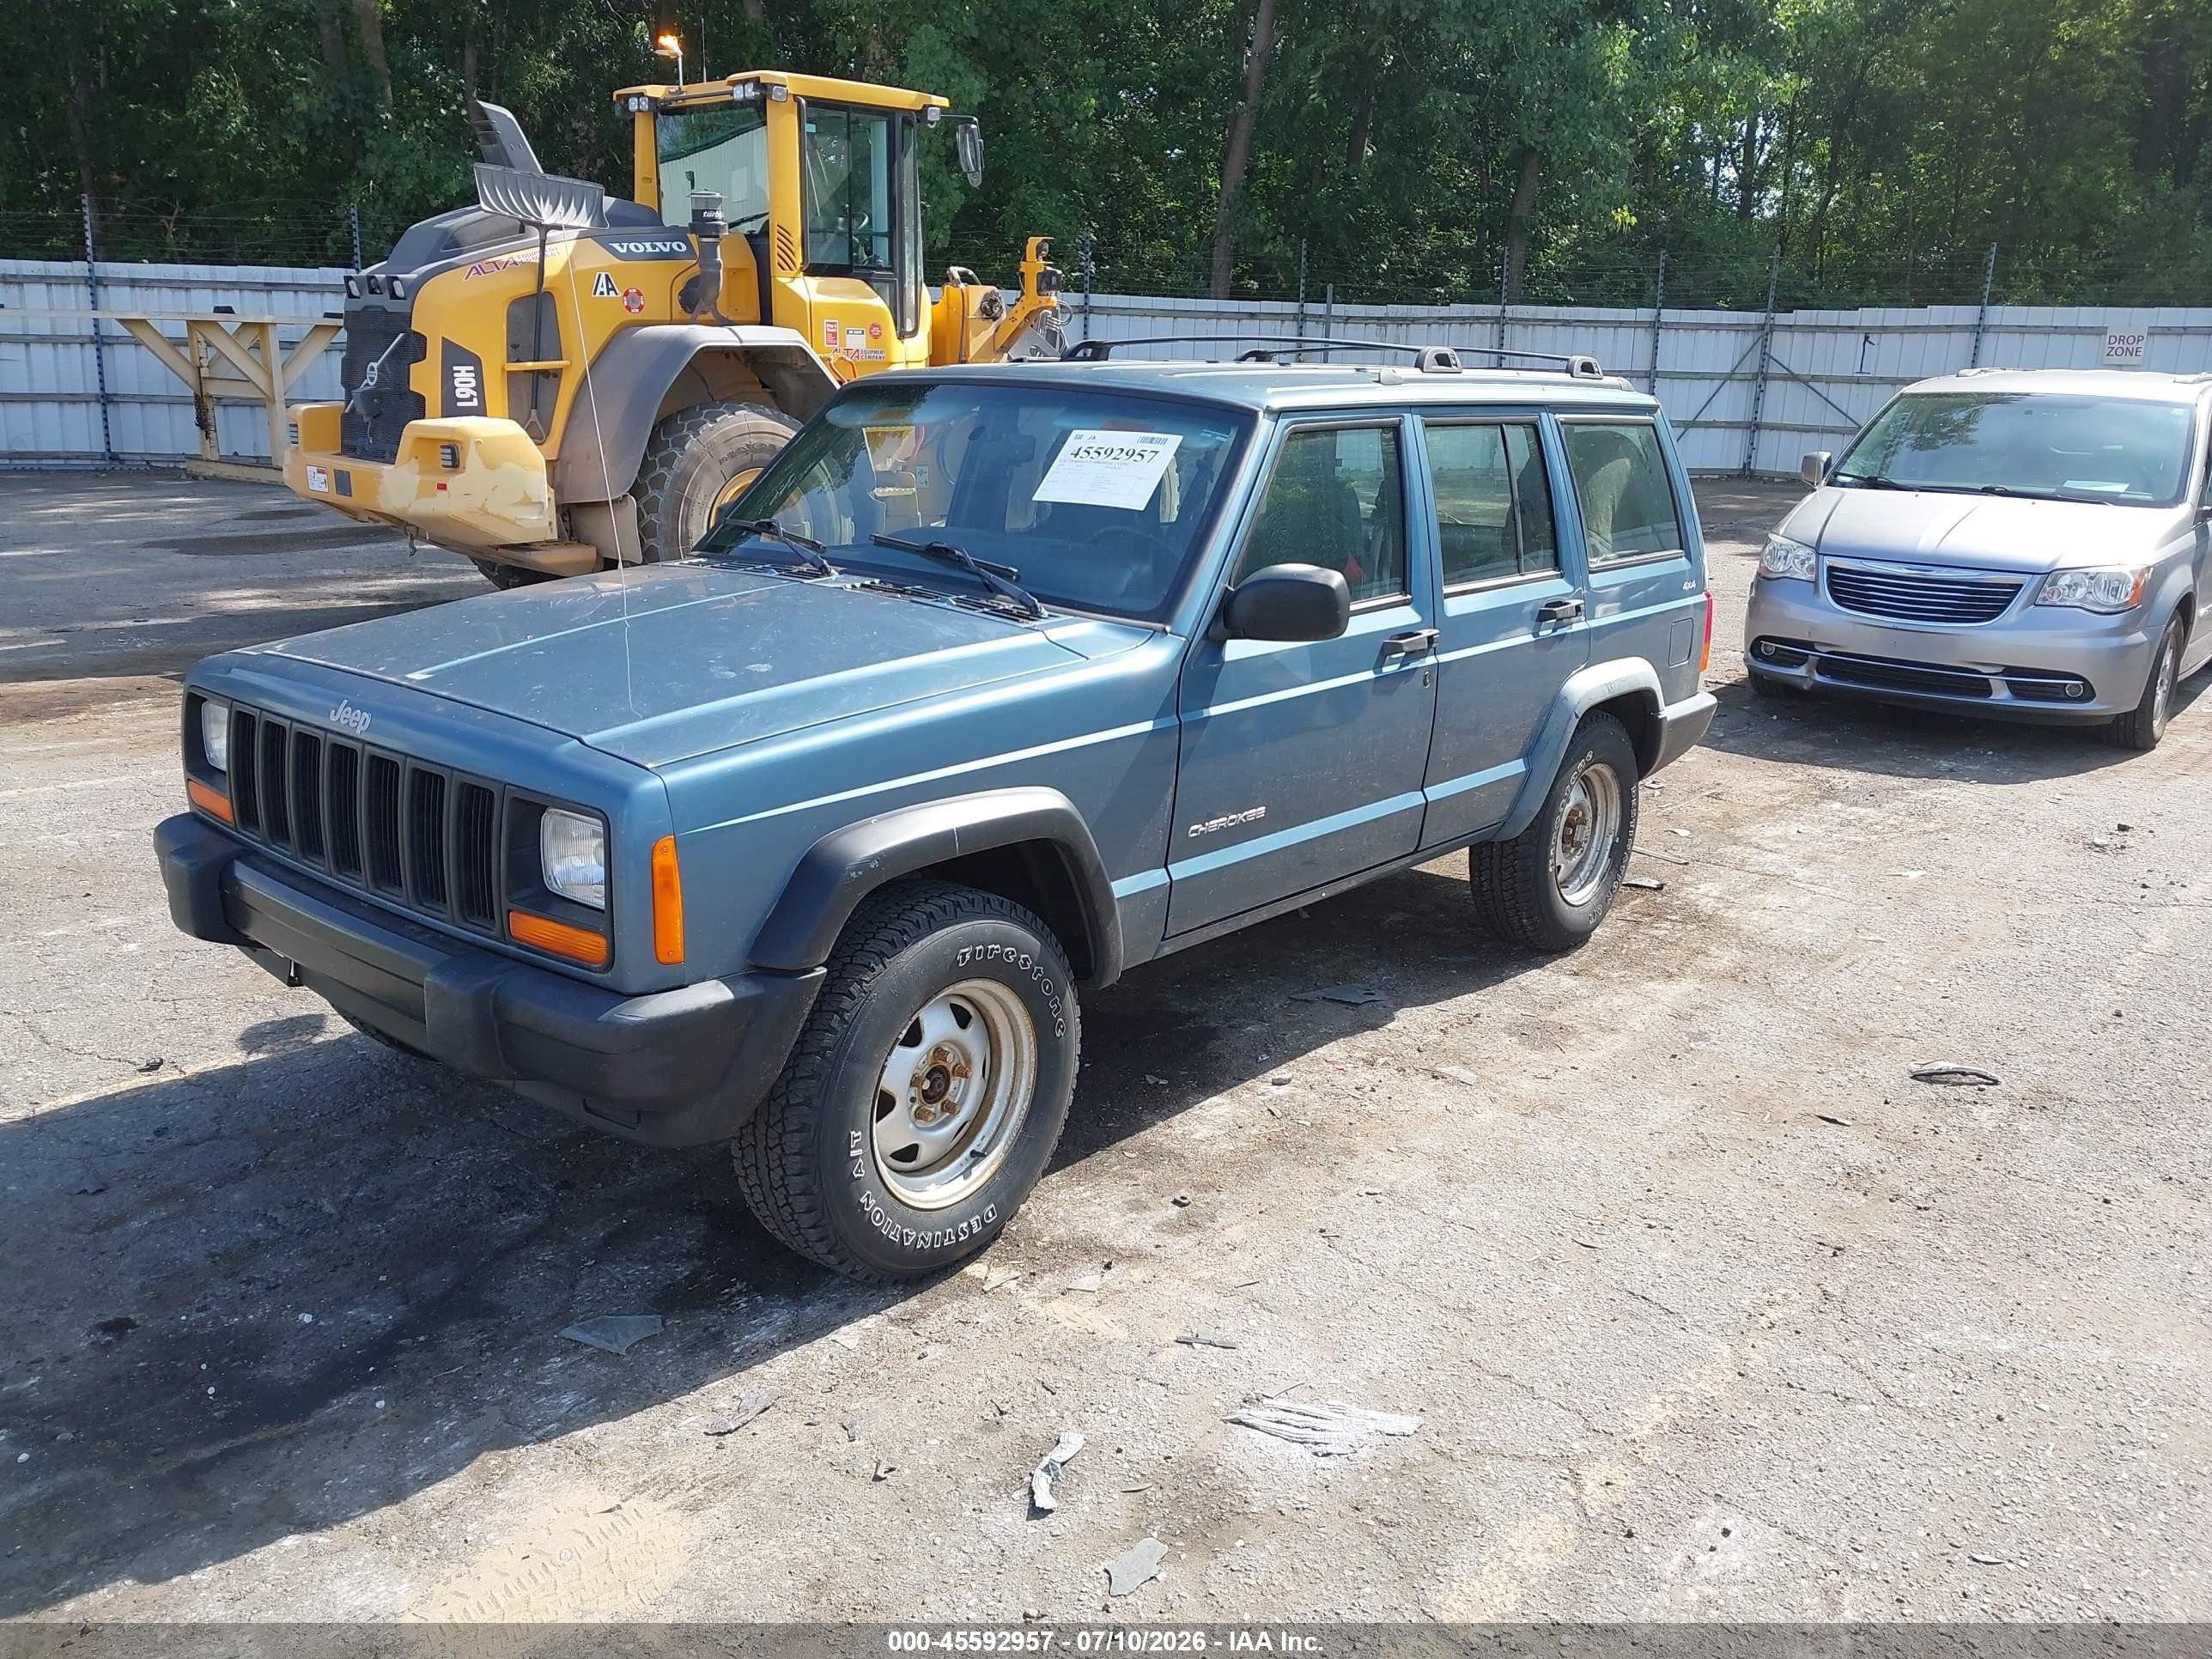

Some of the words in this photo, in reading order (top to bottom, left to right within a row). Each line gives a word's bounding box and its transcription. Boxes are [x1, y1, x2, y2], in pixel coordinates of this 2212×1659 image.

[608, 240, 688, 253] VOLVO
[464, 257, 520, 280] ALTA
[2106, 346, 2142, 357] ZONE
[2108, 335, 2144, 345] DROP
[453, 365, 478, 407] L90H
[1070, 446, 1160, 464] 45592957
[329, 699, 372, 735] Jeep
[1188, 805, 1267, 838] CHEROKEE
[956, 944, 1066, 1038] Firestone
[860, 1191, 999, 1249] DESTINATION
